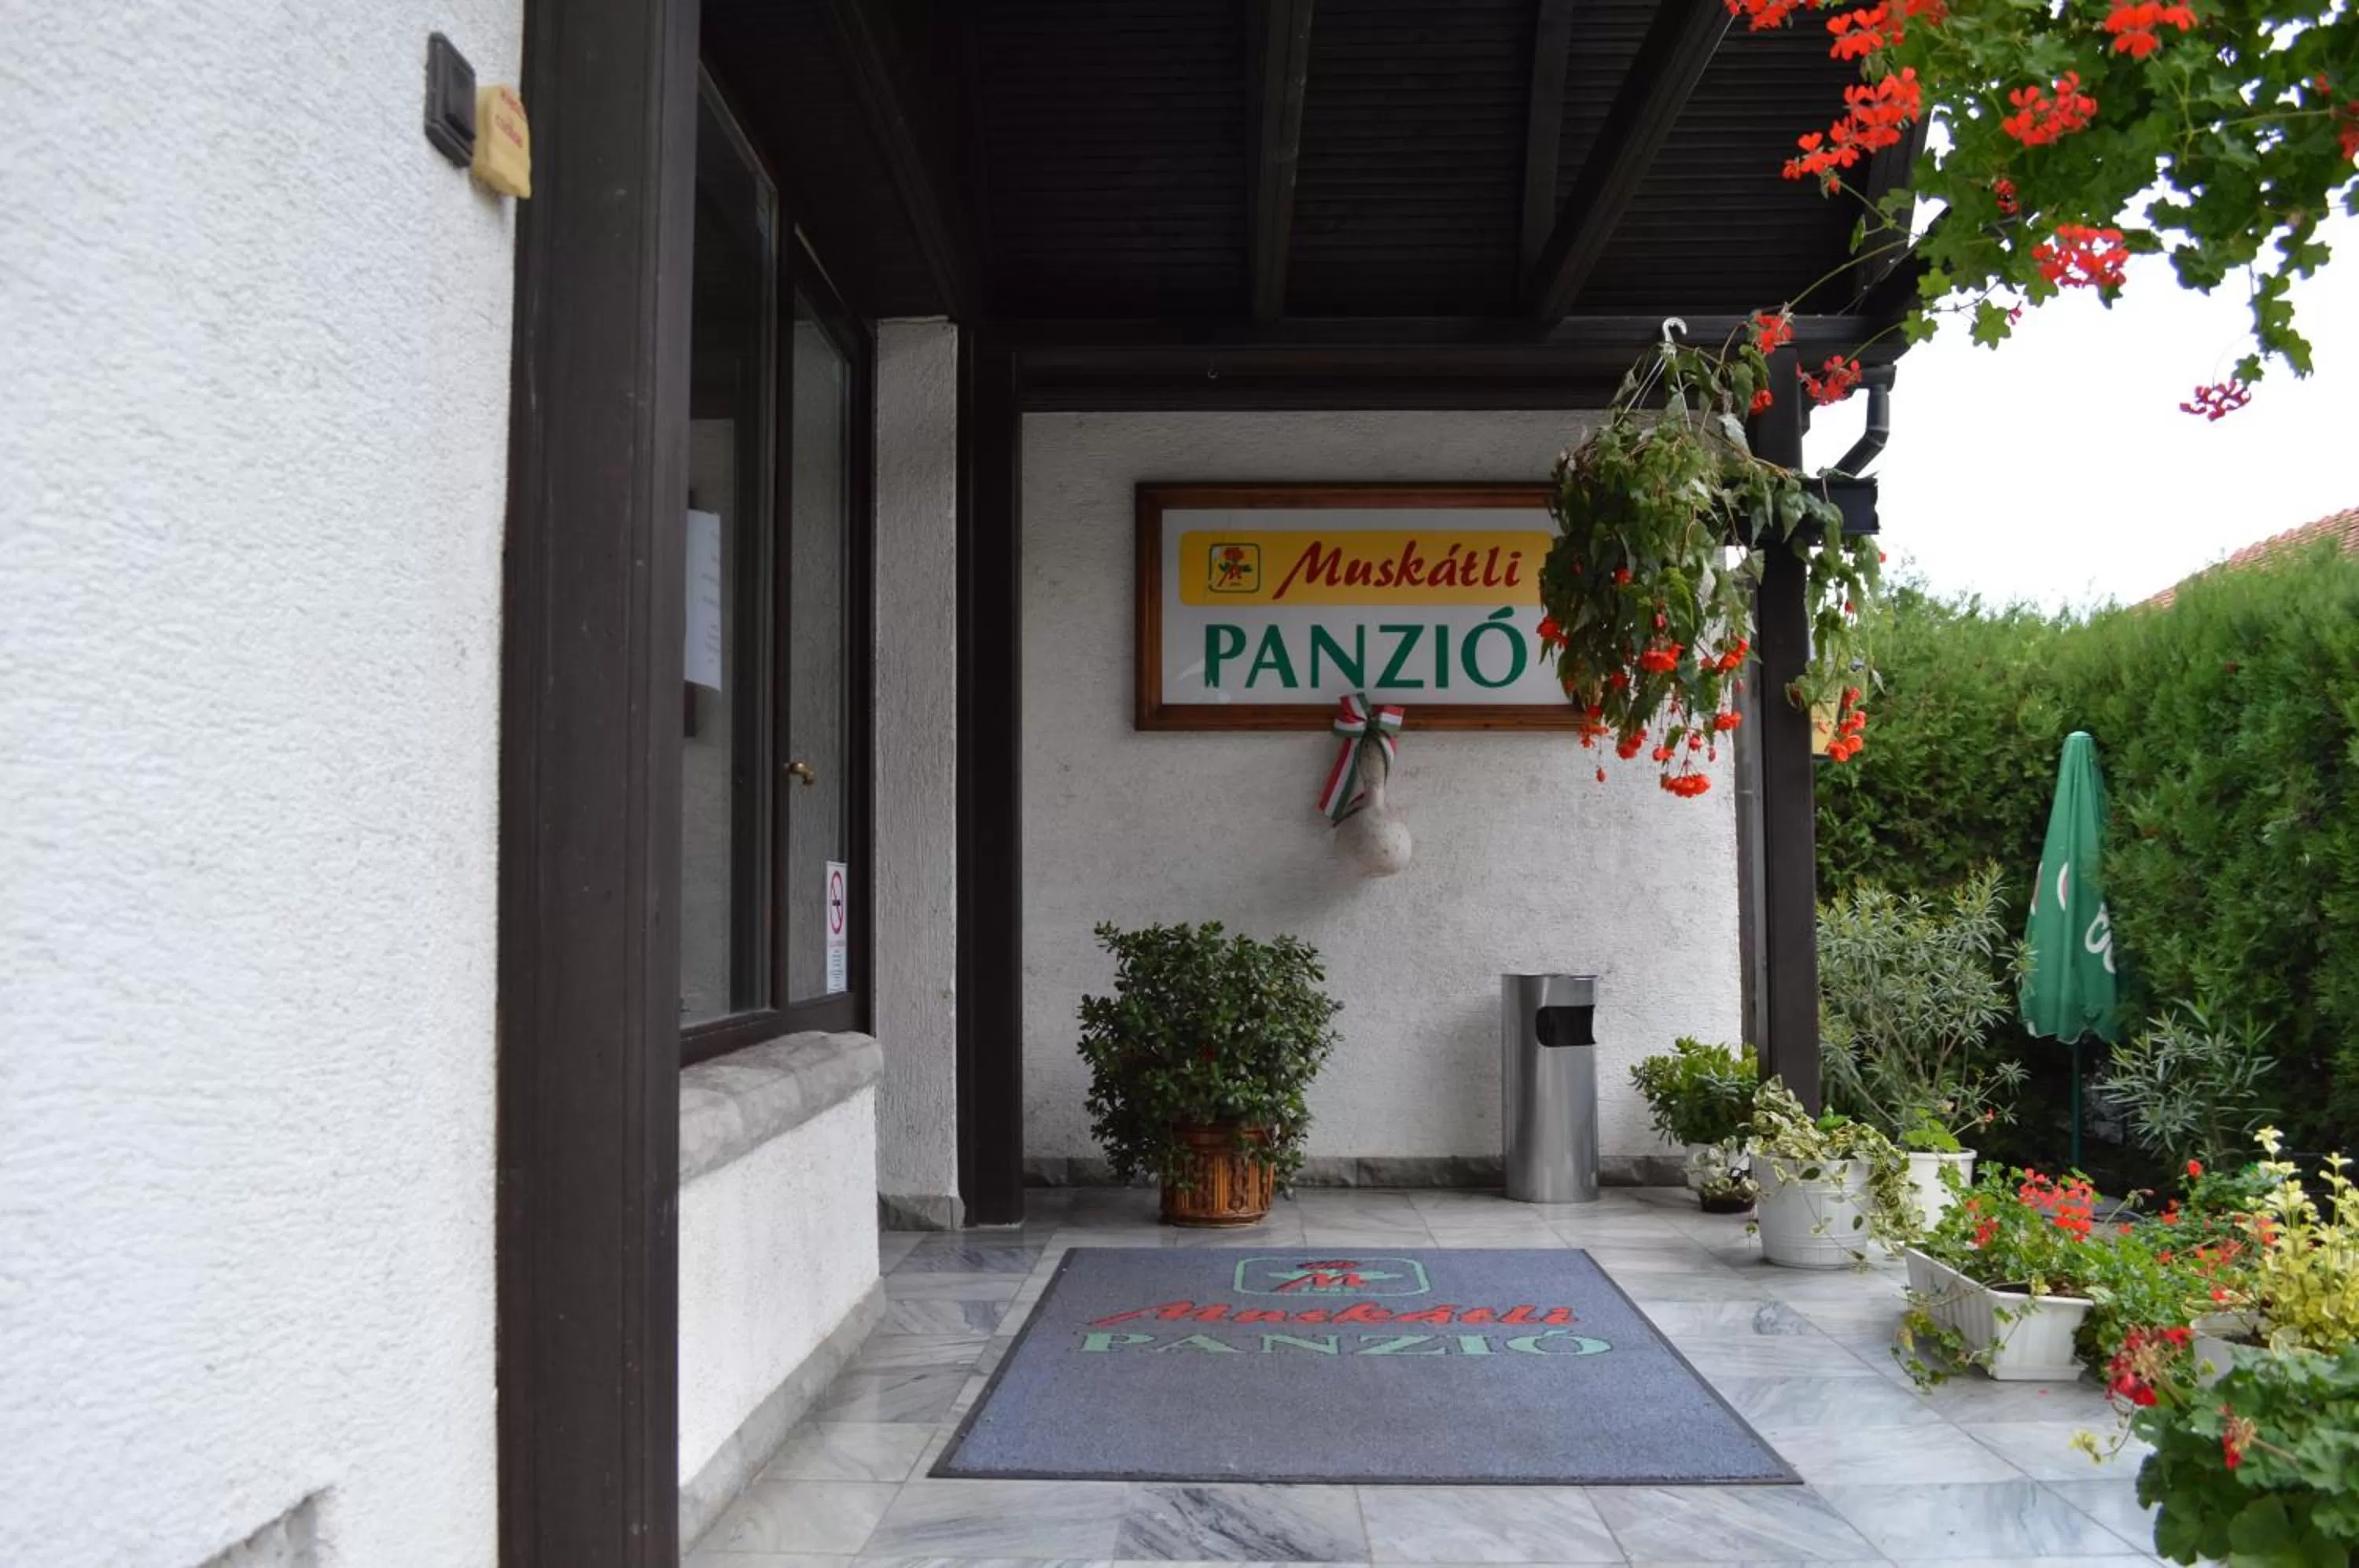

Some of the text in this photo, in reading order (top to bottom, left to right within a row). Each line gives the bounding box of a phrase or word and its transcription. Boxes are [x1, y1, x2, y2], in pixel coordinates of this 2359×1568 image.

[1272, 539, 1522, 600] Muskátli
[1204, 605, 1528, 689] PANZIÓ
[1078, 1330, 1614, 1356] PANZIÓ
